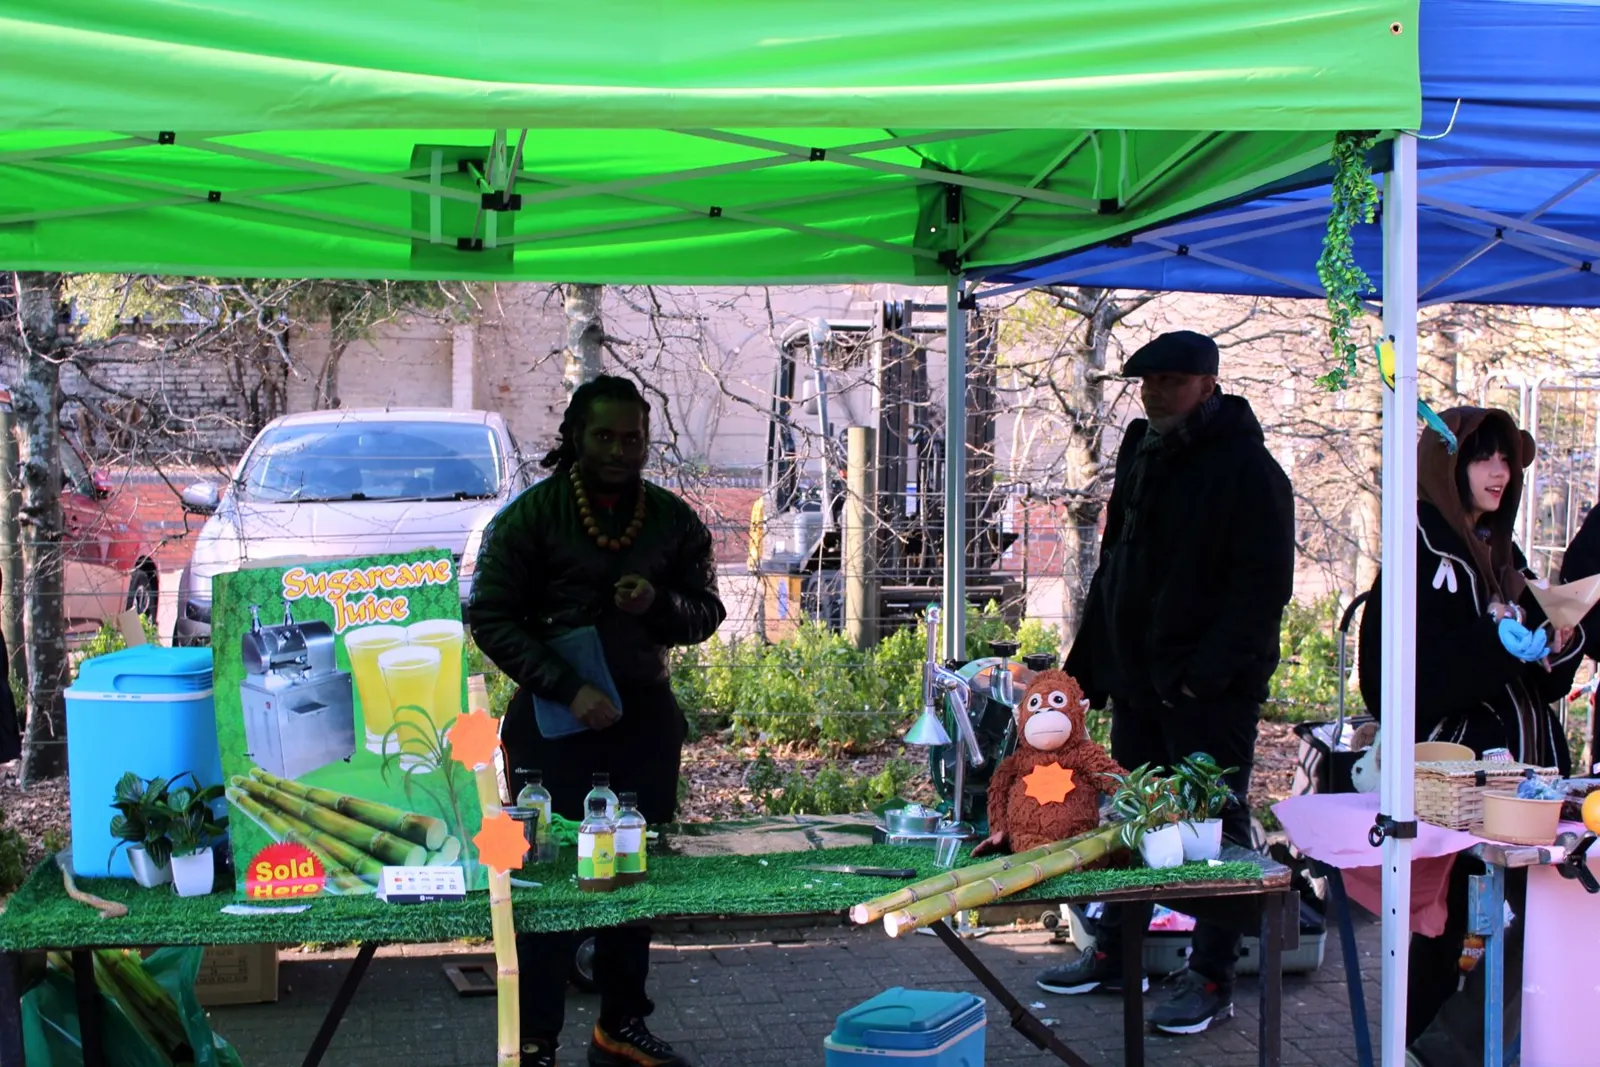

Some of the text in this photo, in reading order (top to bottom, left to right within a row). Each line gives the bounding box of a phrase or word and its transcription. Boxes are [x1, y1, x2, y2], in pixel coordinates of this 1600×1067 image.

[282, 559, 451, 600] Sugarcane
[334, 595, 408, 632] Juice
[256, 857, 315, 882] Sold
[253, 882, 319, 899] Here
